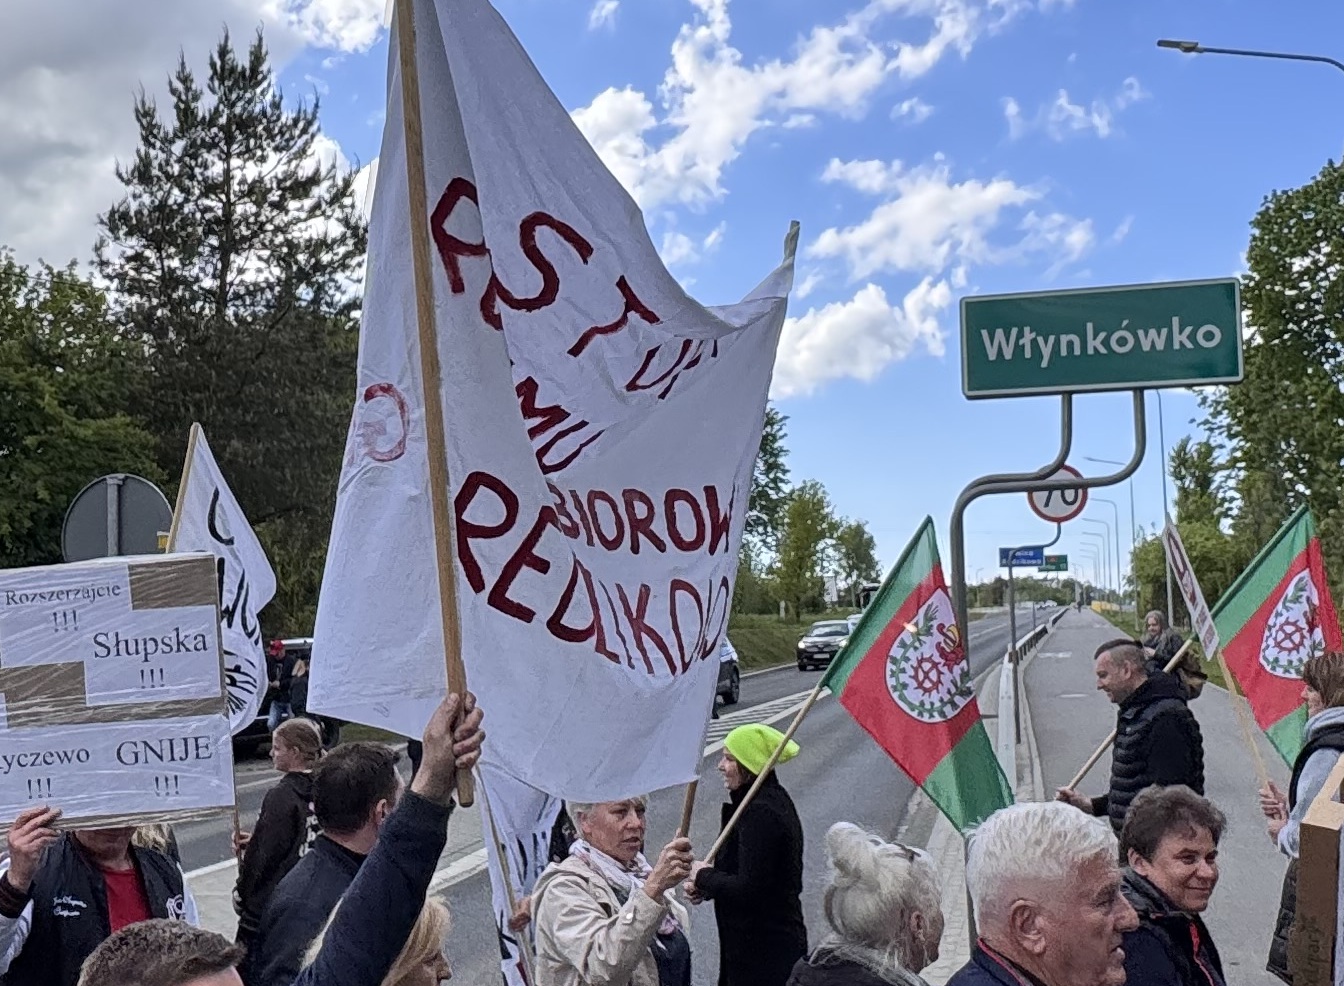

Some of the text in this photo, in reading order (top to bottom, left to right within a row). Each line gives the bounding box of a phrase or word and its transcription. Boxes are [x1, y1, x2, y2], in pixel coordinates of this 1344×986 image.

[981, 316, 1222, 369] Włynkówko
[3, 582, 122, 607] Rozszerzajcie
[51, 610, 80, 633] !!!
[93, 627, 209, 664] Słupska
[139, 668, 166, 689] !!!
[116, 735, 214, 767] GNIJE
[27, 778, 53, 800] !!!
[154, 775, 181, 797] !!!
